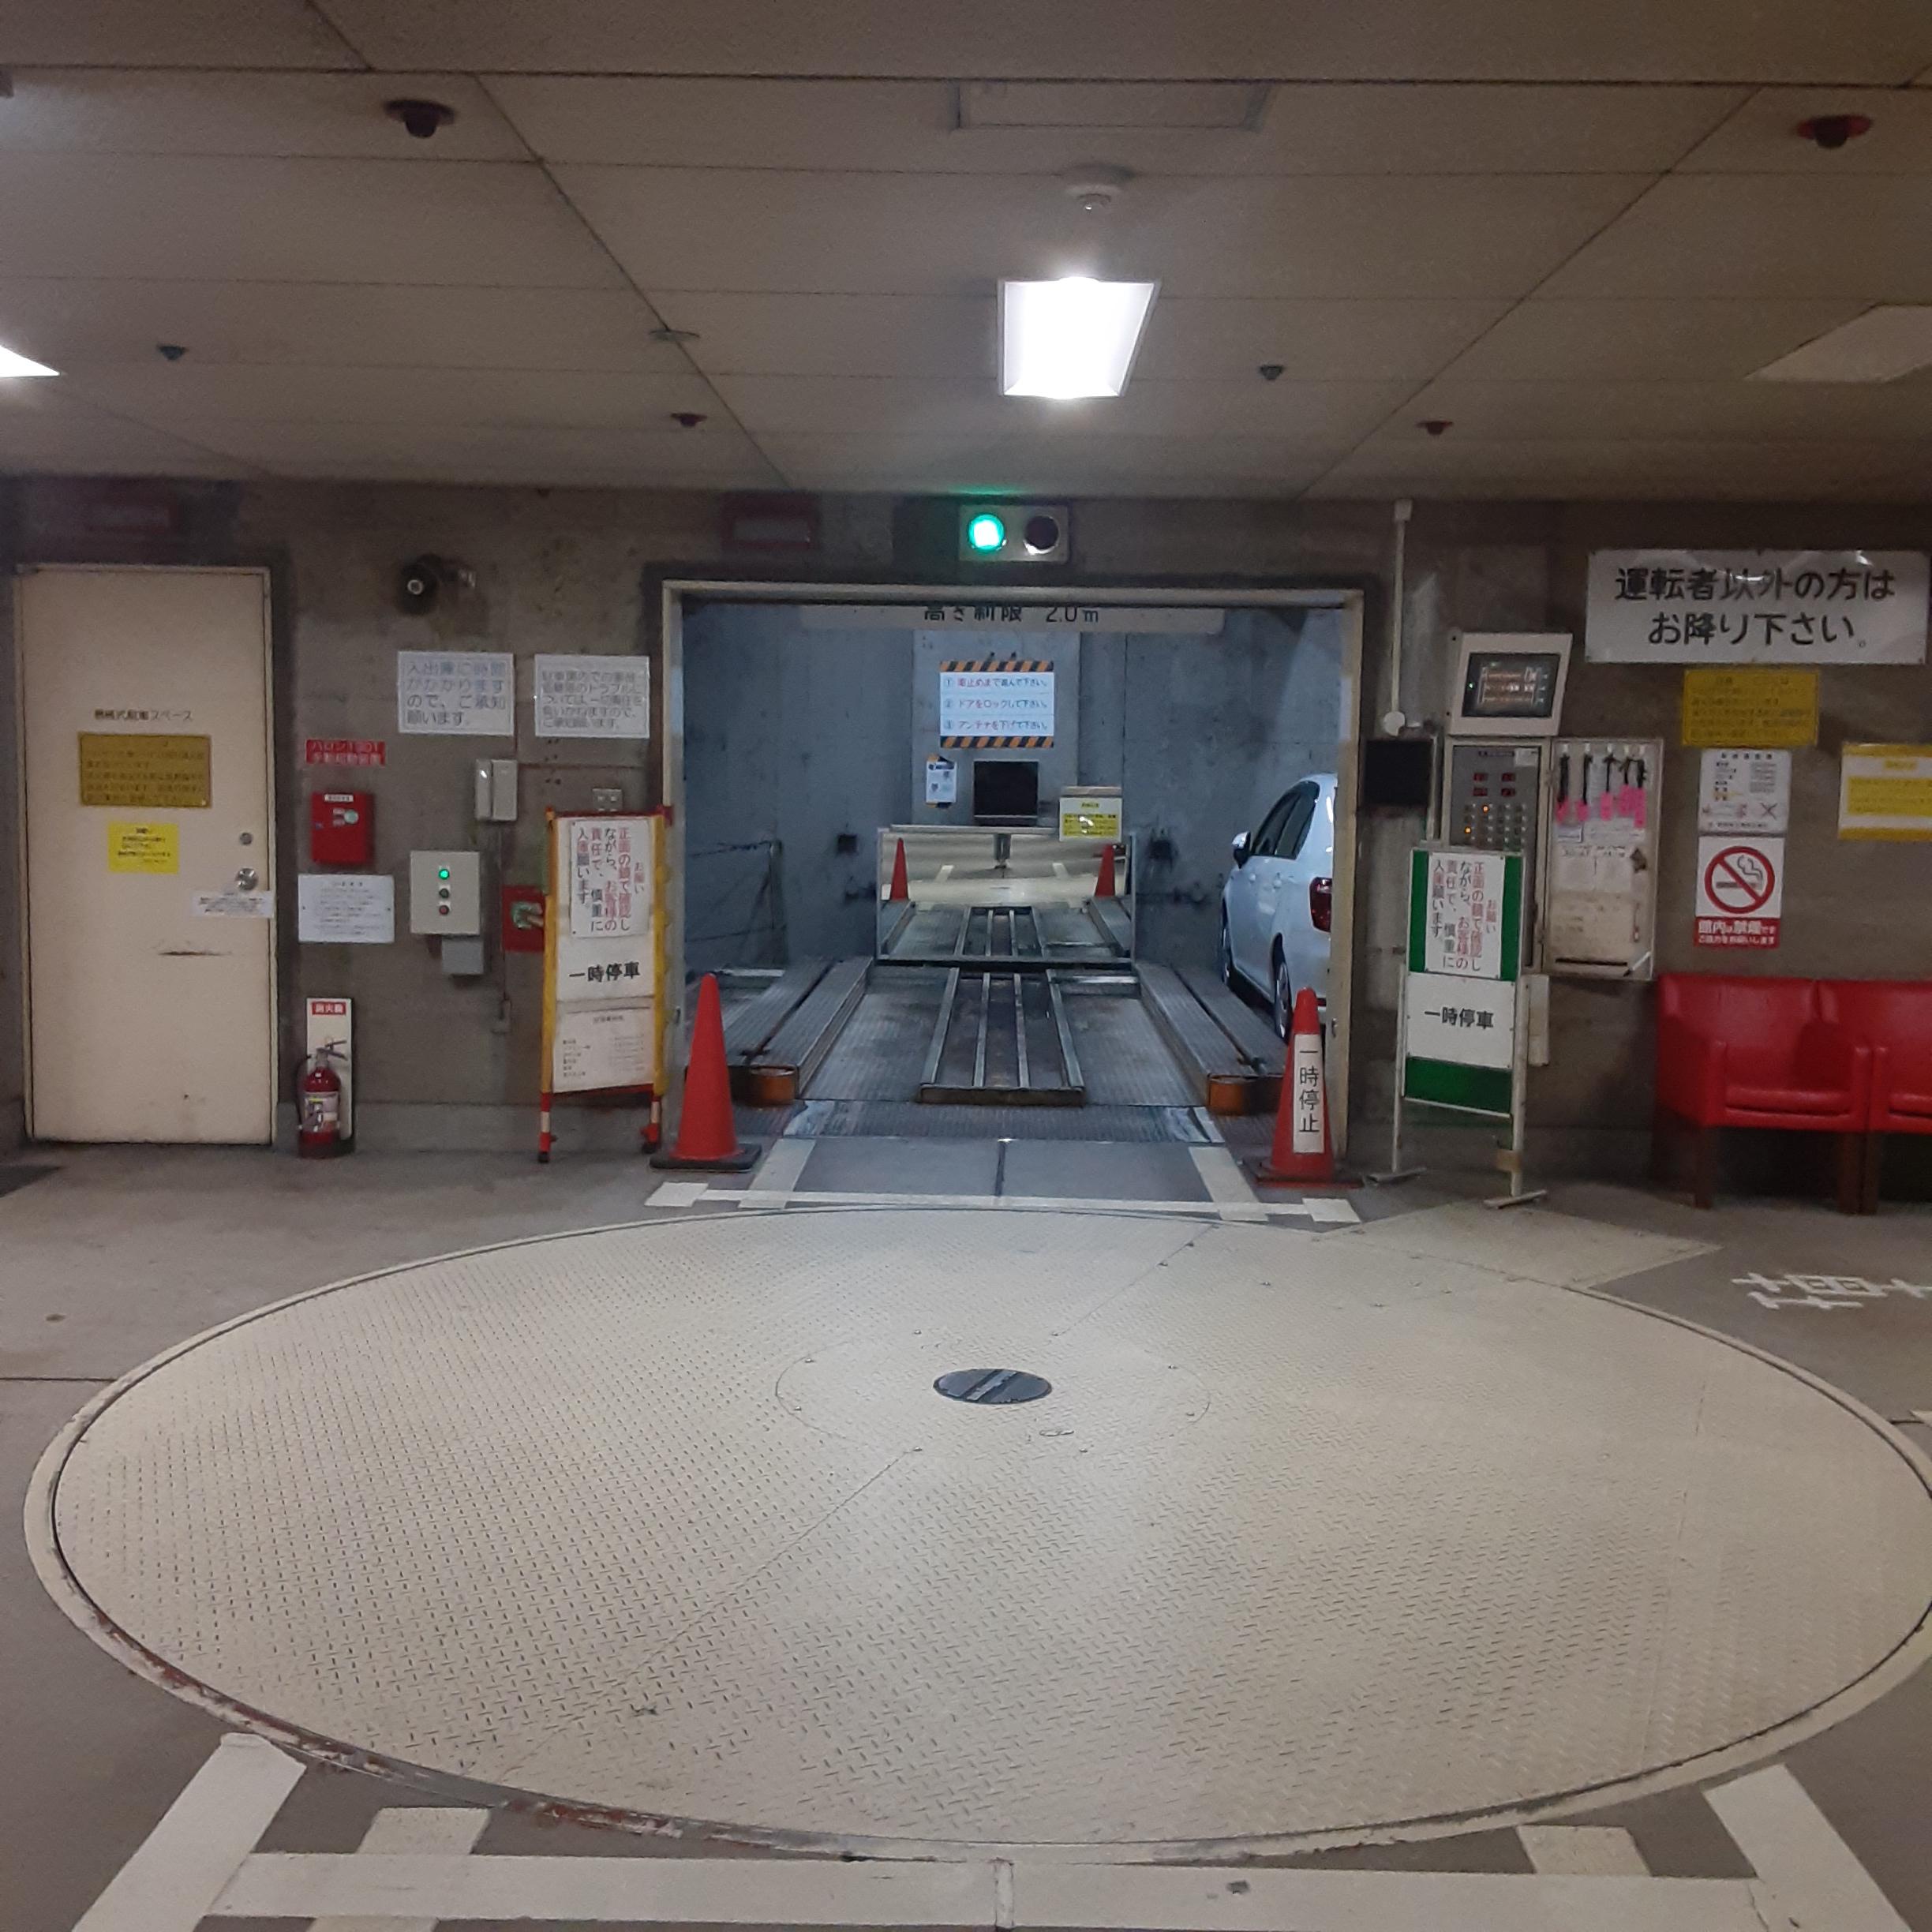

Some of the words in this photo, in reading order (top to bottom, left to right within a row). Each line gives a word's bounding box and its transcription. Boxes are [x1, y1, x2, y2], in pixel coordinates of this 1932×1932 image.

[1616, 567, 1896, 601] 運転者以外の方は
[1648, 611, 1866, 648] お降り下さい。
[569, 961, 640, 983] 一時停車
[1425, 1007, 1494, 1030] 一時停車
[1299, 1050, 1320, 1133] 一時停止
